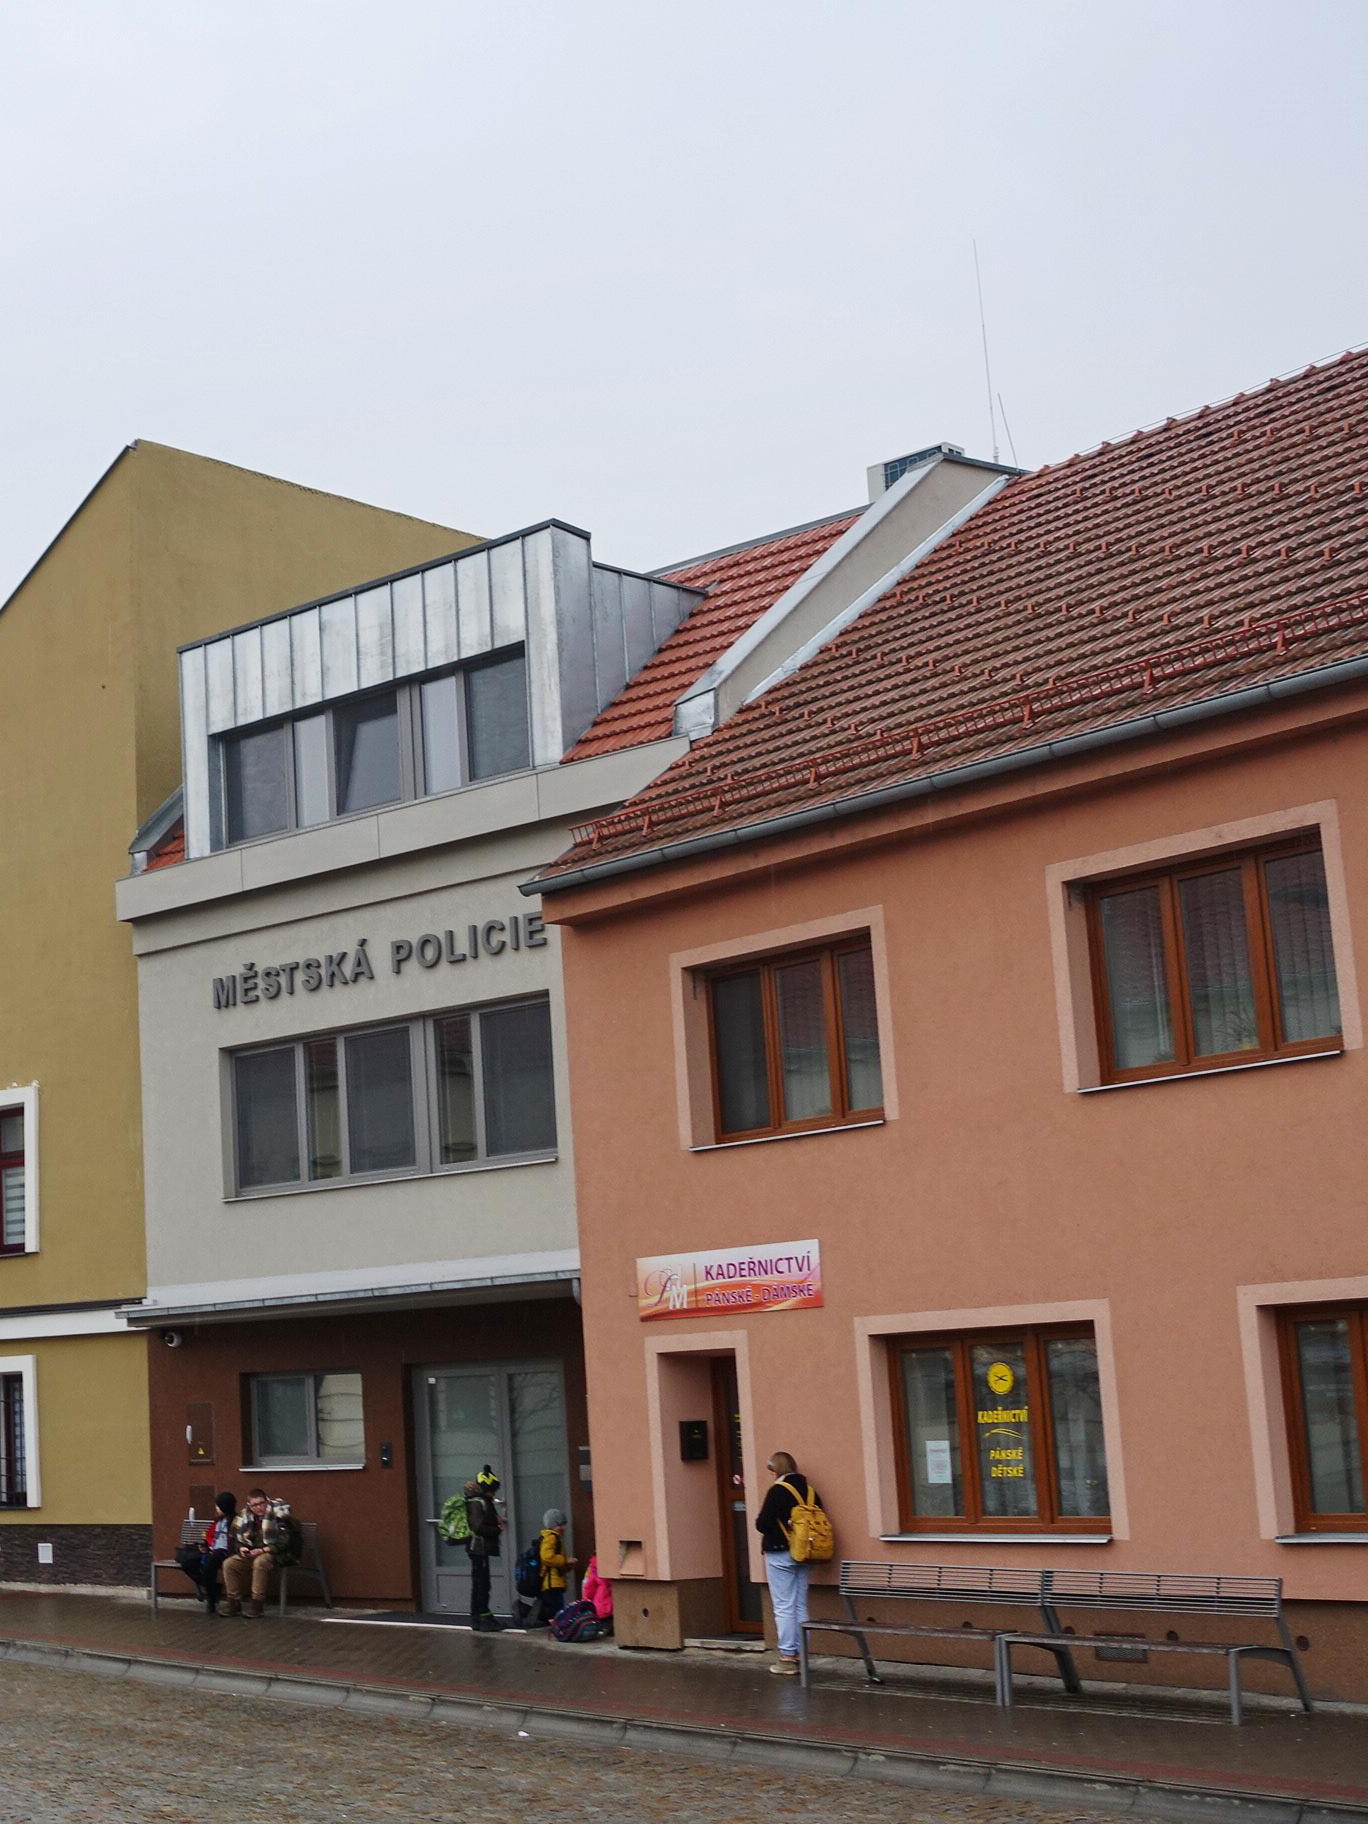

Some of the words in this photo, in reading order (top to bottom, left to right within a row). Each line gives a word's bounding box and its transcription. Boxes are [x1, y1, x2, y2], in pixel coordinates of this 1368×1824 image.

[212, 937, 374, 1010] MĚSTSKÁ
[390, 911, 547, 975] POLICIE
[704, 1250, 811, 1281] KADEŘNICTVÍ
[706, 1287, 753, 1305] PÁNSKÉ
[762, 1282, 814, 1301] DÁMSKÉ
[989, 1447, 1024, 1460] PÁNSKÉ
